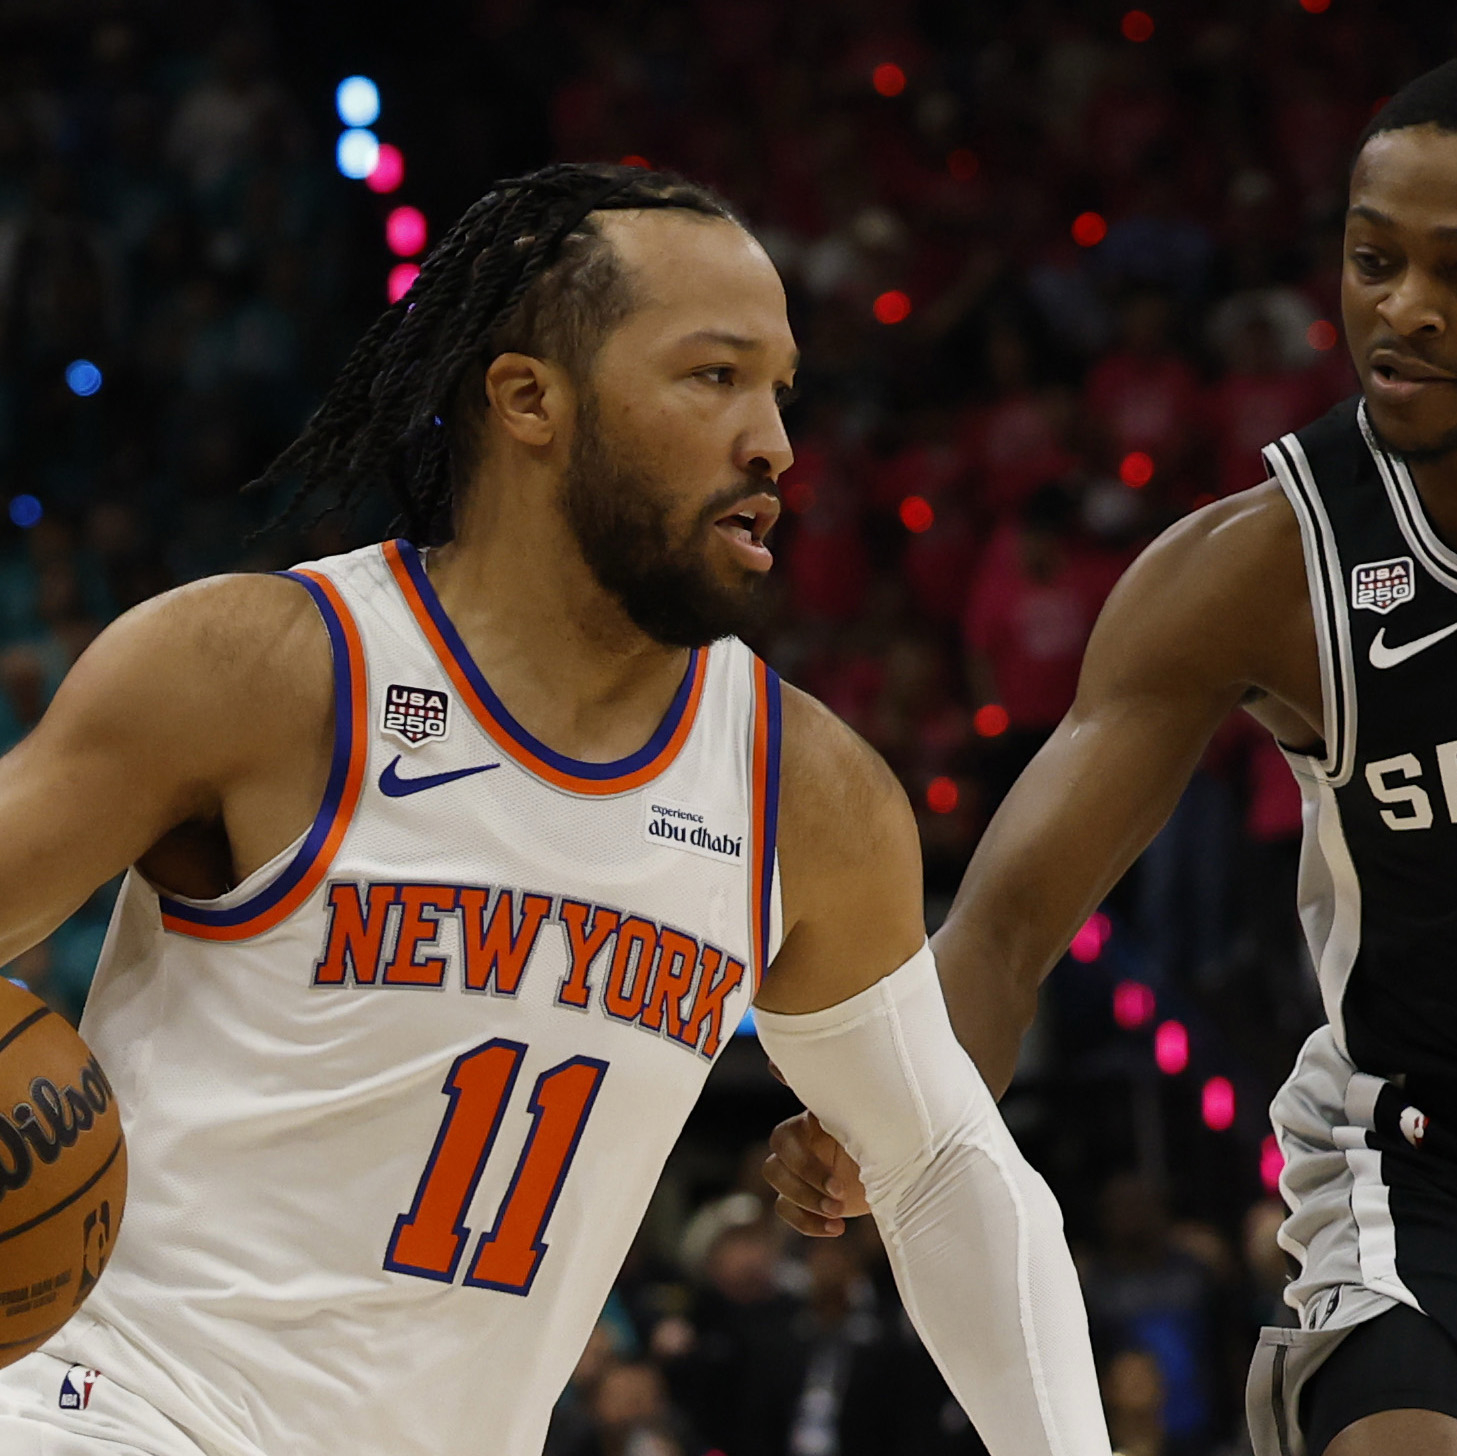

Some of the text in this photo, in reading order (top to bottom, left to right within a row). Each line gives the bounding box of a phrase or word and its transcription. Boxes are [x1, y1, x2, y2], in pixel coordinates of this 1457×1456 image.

[1360, 565, 1407, 583] USA
[1358, 584, 1410, 604] 250
[391, 689, 444, 710] USA
[386, 713, 445, 736] 250
[651, 804, 704, 824] experience
[649, 818, 686, 843] abu
[310, 880, 747, 1064] NEW YORK
[382, 1037, 610, 1297] 11
